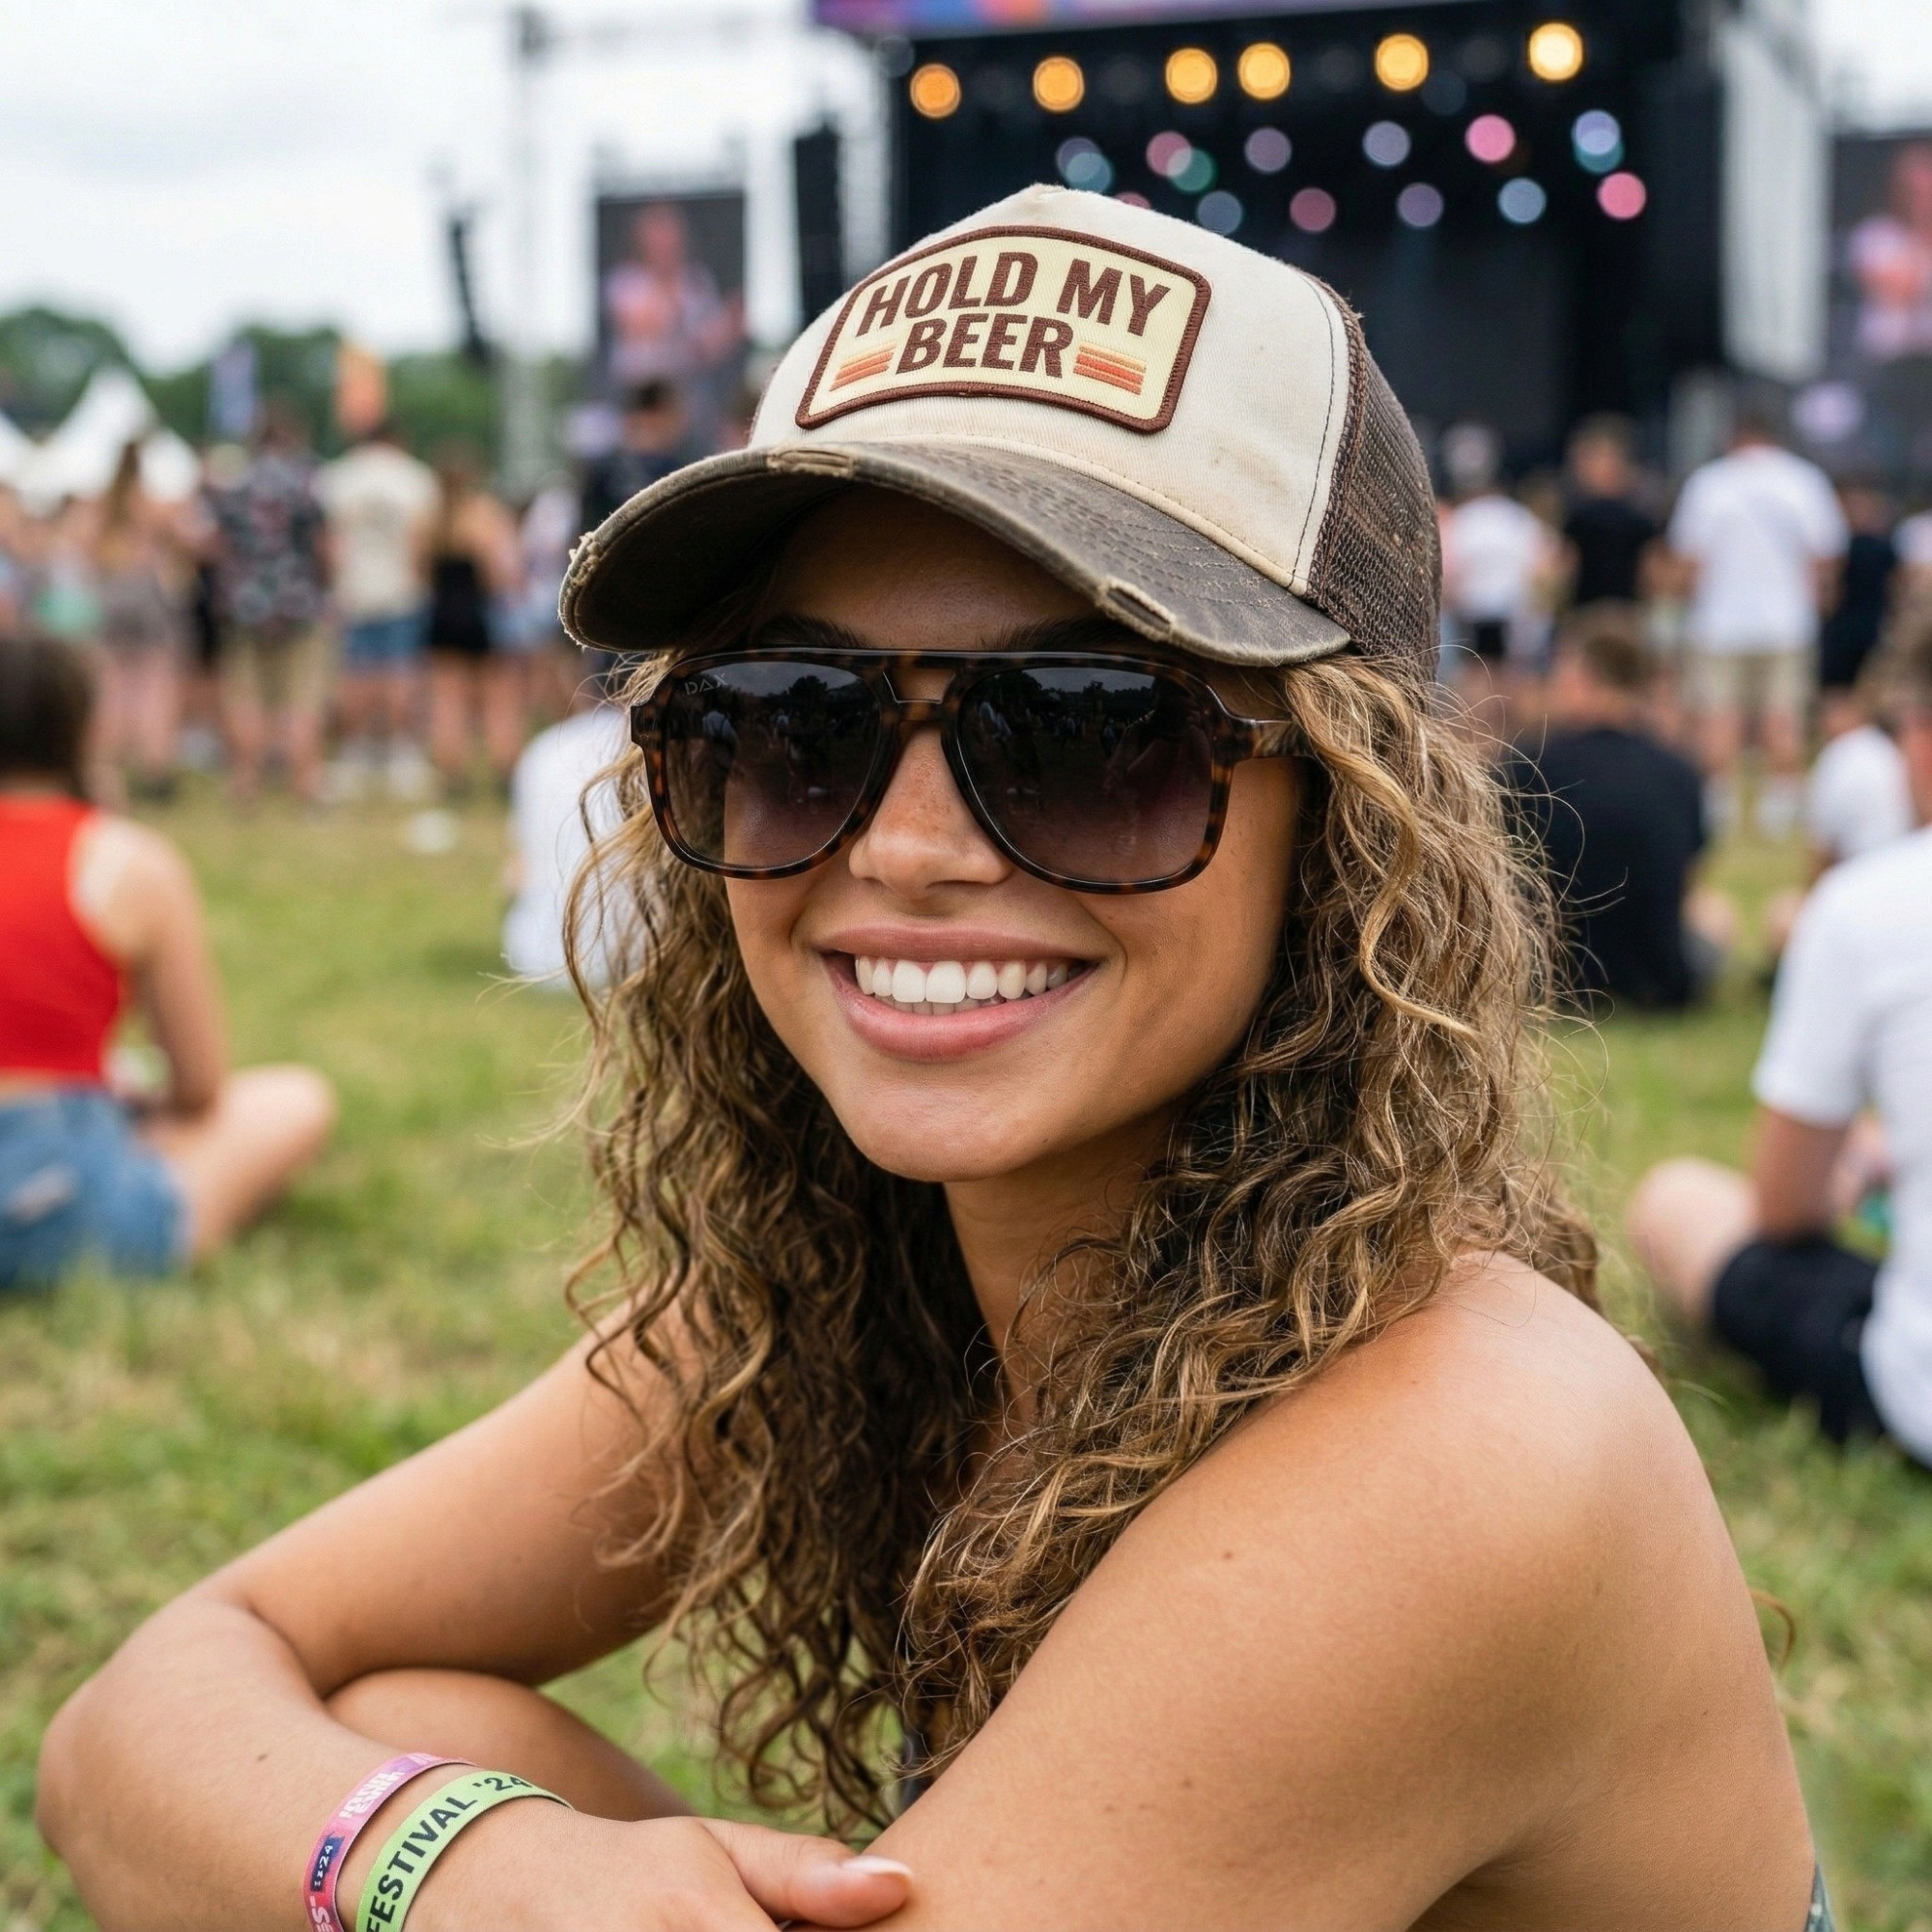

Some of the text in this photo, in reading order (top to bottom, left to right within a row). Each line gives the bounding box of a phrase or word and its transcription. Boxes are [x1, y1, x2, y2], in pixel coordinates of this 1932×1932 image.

[856, 252, 1171, 337] HOLD MY
[895, 313, 1074, 378] BEER
[684, 672, 729, 696] DAX
[366, 1797, 478, 1932] FESTIVAL
